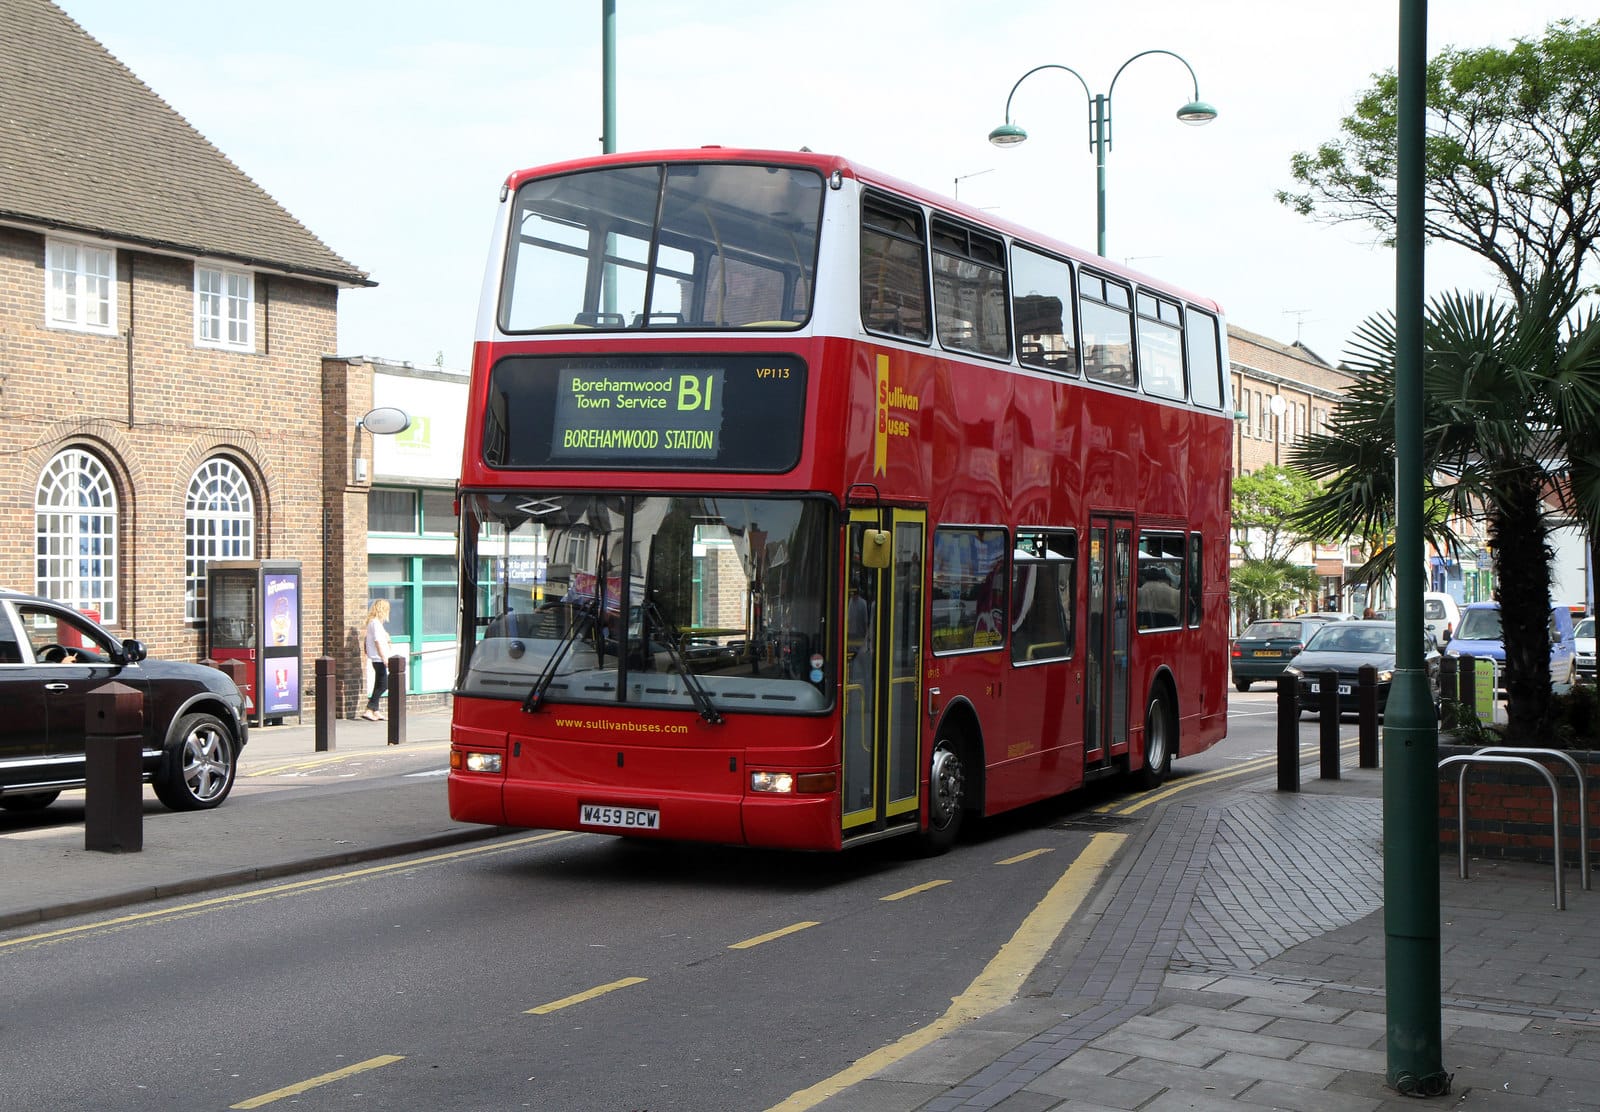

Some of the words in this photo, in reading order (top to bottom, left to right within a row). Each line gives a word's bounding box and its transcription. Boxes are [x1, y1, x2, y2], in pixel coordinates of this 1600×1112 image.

[756, 368, 790, 379] VP113
[572, 377, 673, 392] Borehamwood
[677, 374, 714, 411] B1
[879, 379, 919, 411] Sullivan
[575, 394, 611, 409] Town
[616, 394, 667, 409] Service
[879, 408, 910, 437] Buses
[564, 429, 659, 449] BOREHAMWOOD
[664, 430, 714, 450] STATION
[555, 718, 689, 734] www.sullivanbuses.com
[584, 807, 622, 825] W459
[625, 811, 657, 828] BCW
